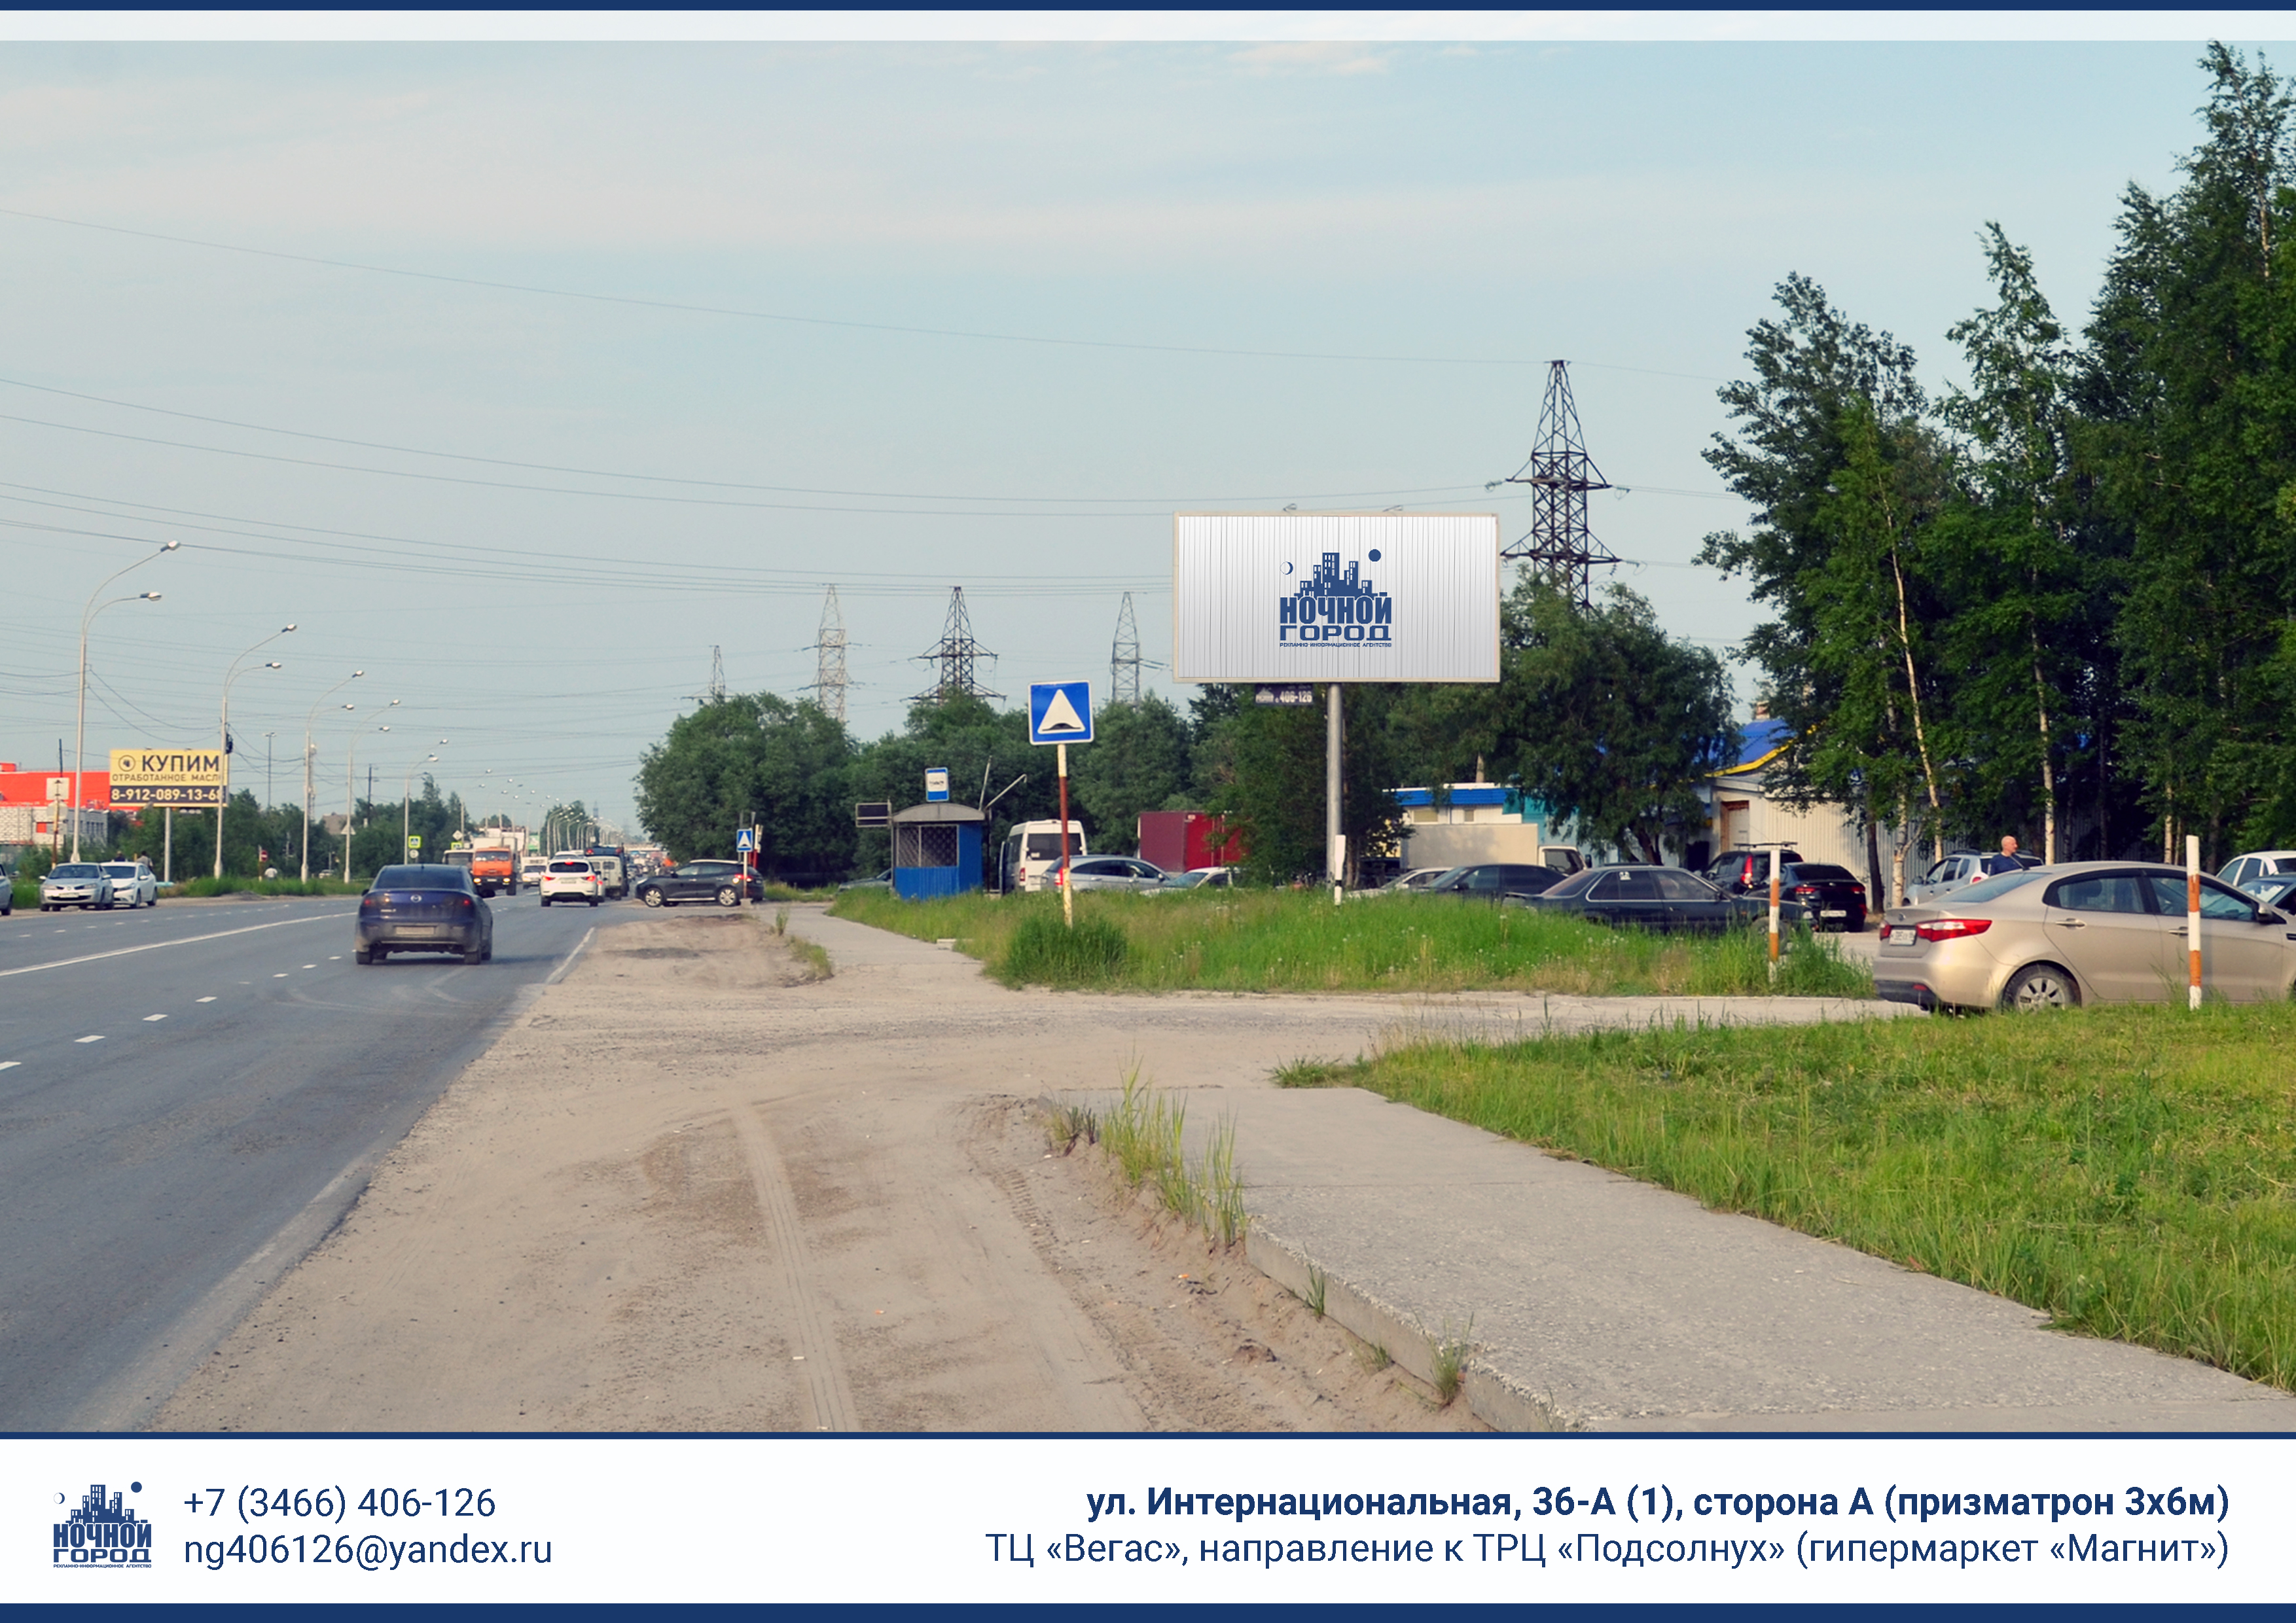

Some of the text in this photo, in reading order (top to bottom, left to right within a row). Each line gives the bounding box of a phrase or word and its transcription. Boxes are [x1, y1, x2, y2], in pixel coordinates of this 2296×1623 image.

[1280, 592, 1391, 624] НОЧНОЙ
[1280, 626, 1391, 641] ГОРОД
[1280, 691, 1312, 702] 406-126
[142, 755, 219, 772] КУПИМ
